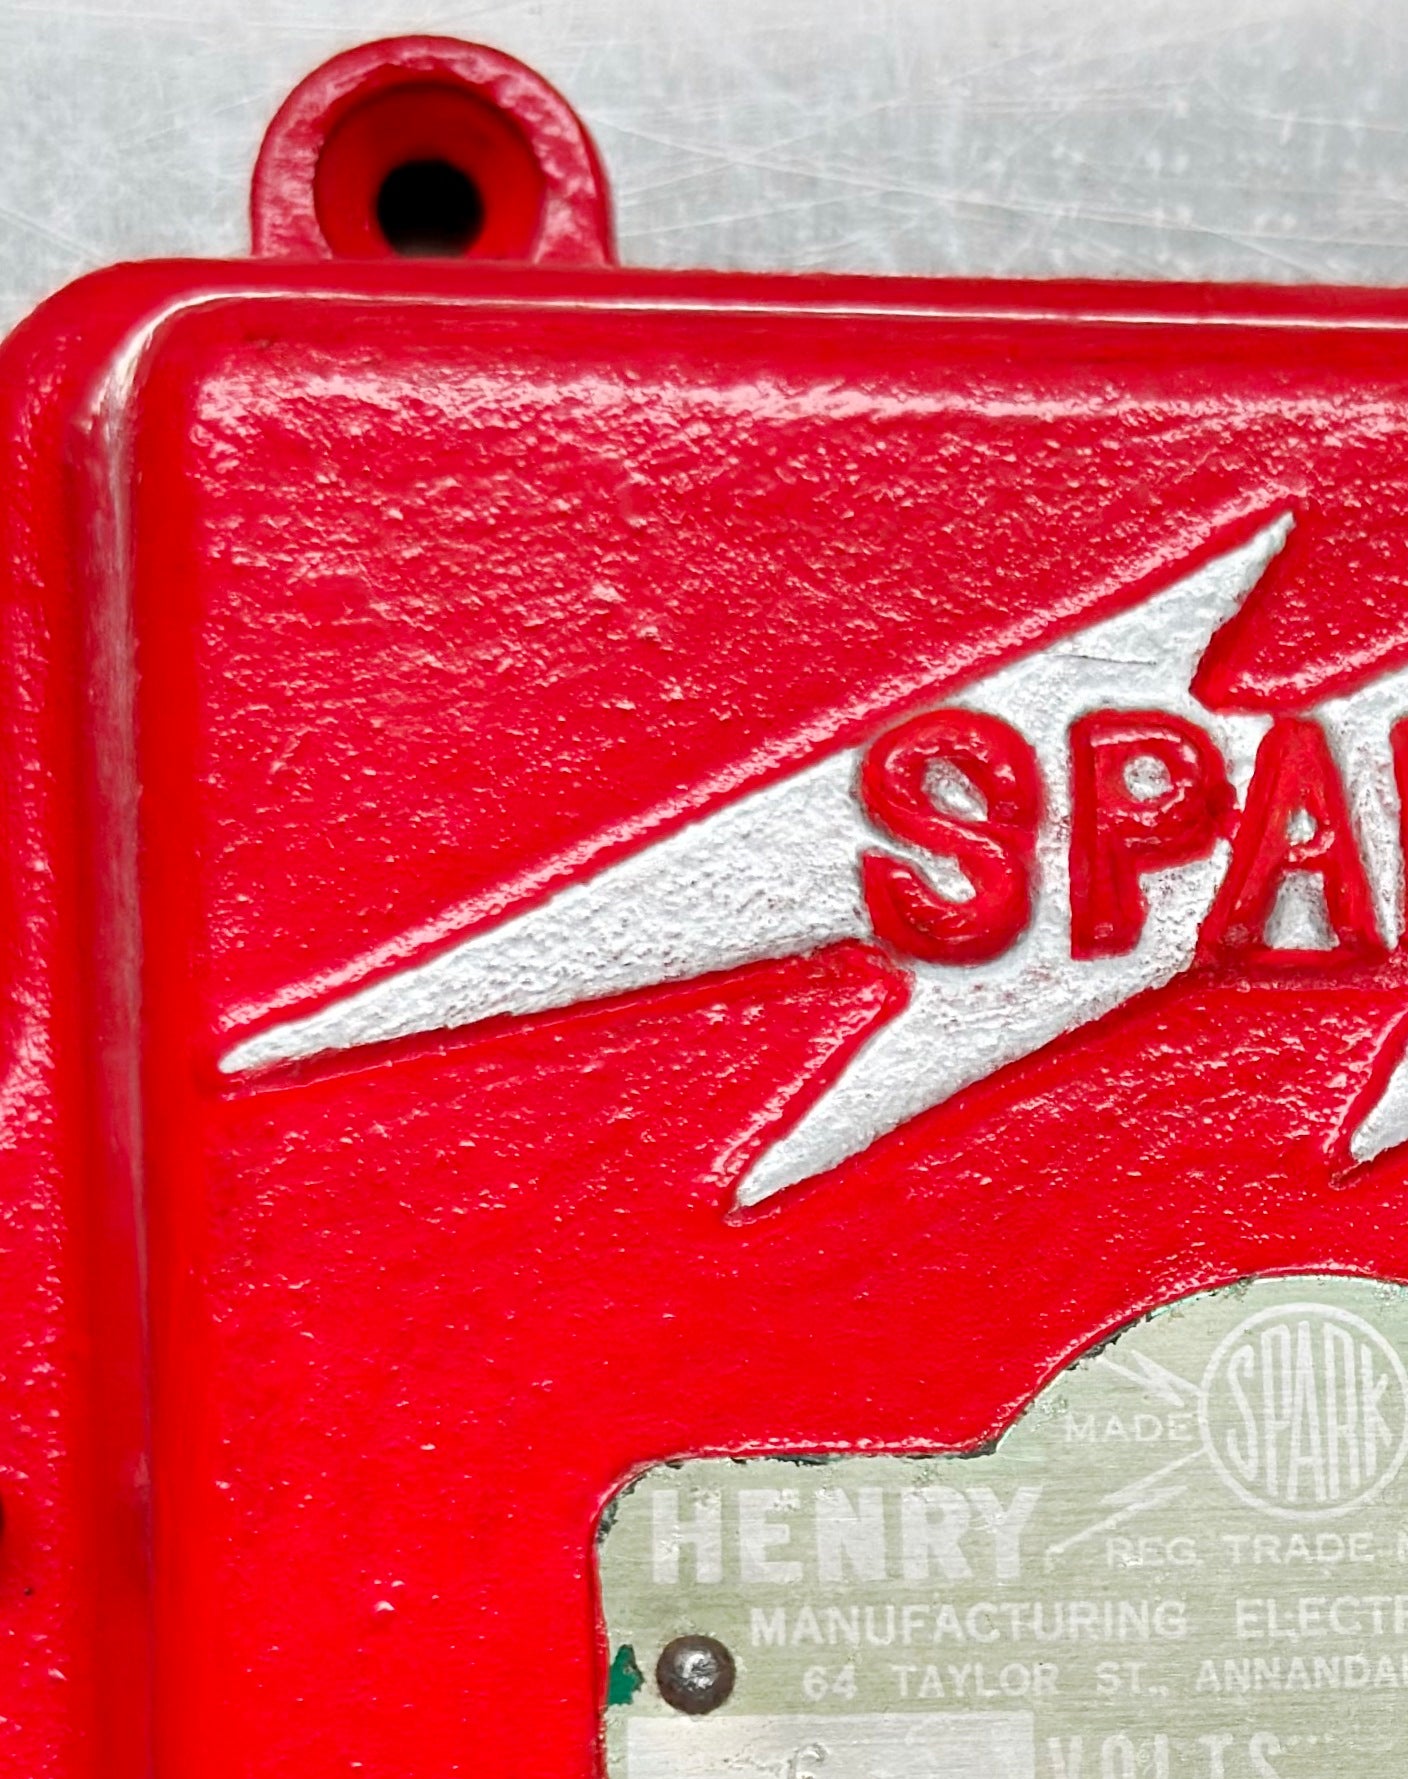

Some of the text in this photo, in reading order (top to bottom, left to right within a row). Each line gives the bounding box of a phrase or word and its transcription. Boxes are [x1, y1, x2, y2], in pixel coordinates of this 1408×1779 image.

[1064, 1411, 1197, 1445] MADE
[1225, 1319, 1394, 1502] SPARK
[651, 1484, 1044, 1585] HENRY
[1222, 1530, 1375, 1566] TRADE
[749, 1596, 1188, 1647] MANUFACTURING
[802, 1664, 860, 1699] 64
[892, 1661, 1061, 1699] TAYLOR
